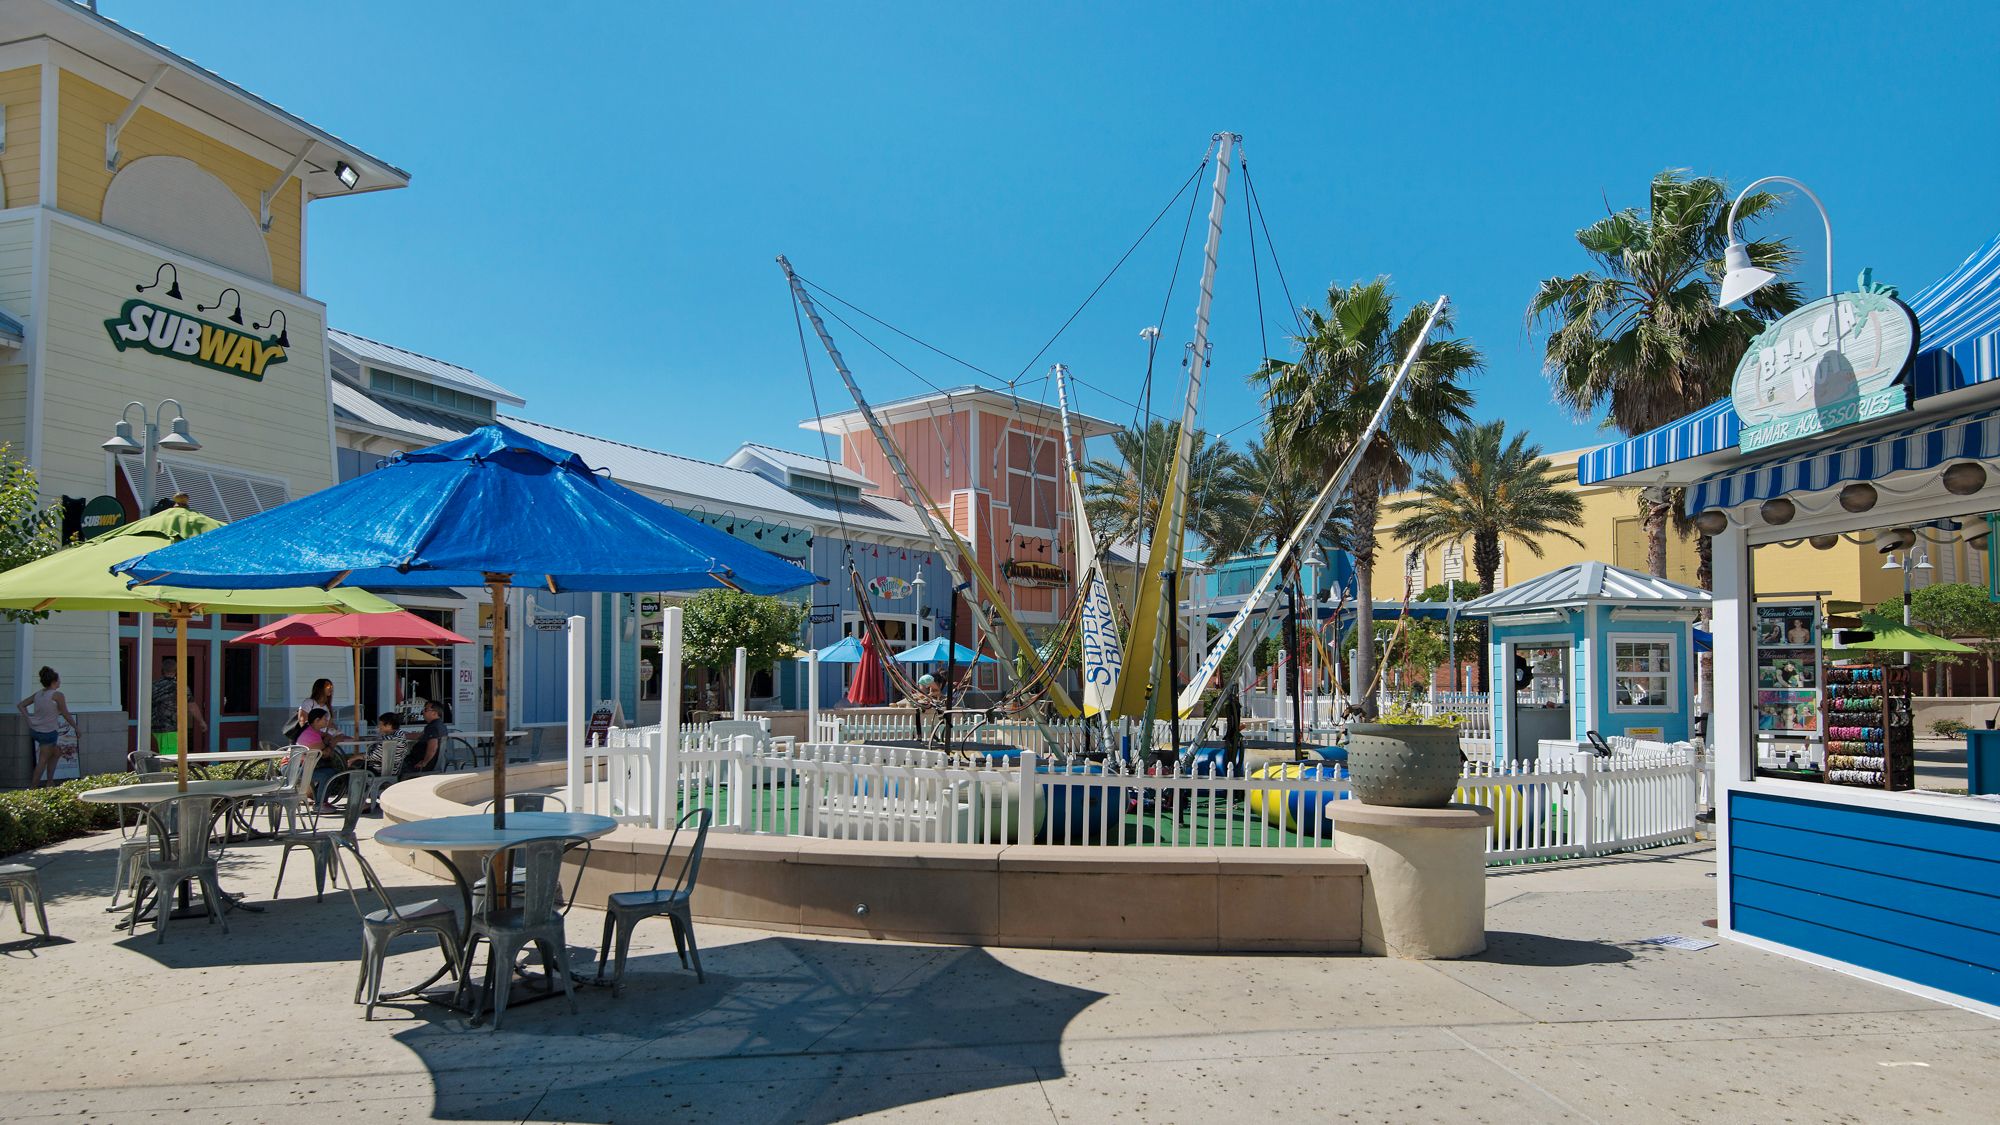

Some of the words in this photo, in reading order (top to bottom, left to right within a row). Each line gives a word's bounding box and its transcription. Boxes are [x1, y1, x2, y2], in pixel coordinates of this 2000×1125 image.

[115, 305, 286, 375] SUBWAY
[1759, 303, 1857, 381] BEACH
[1792, 338, 1846, 401] HUT
[1749, 422, 1789, 448] TAMAR
[1795, 393, 1893, 434] ACCESSORIES
[81, 513, 122, 528] SUBWAY
[1759, 608, 1786, 617] Henna
